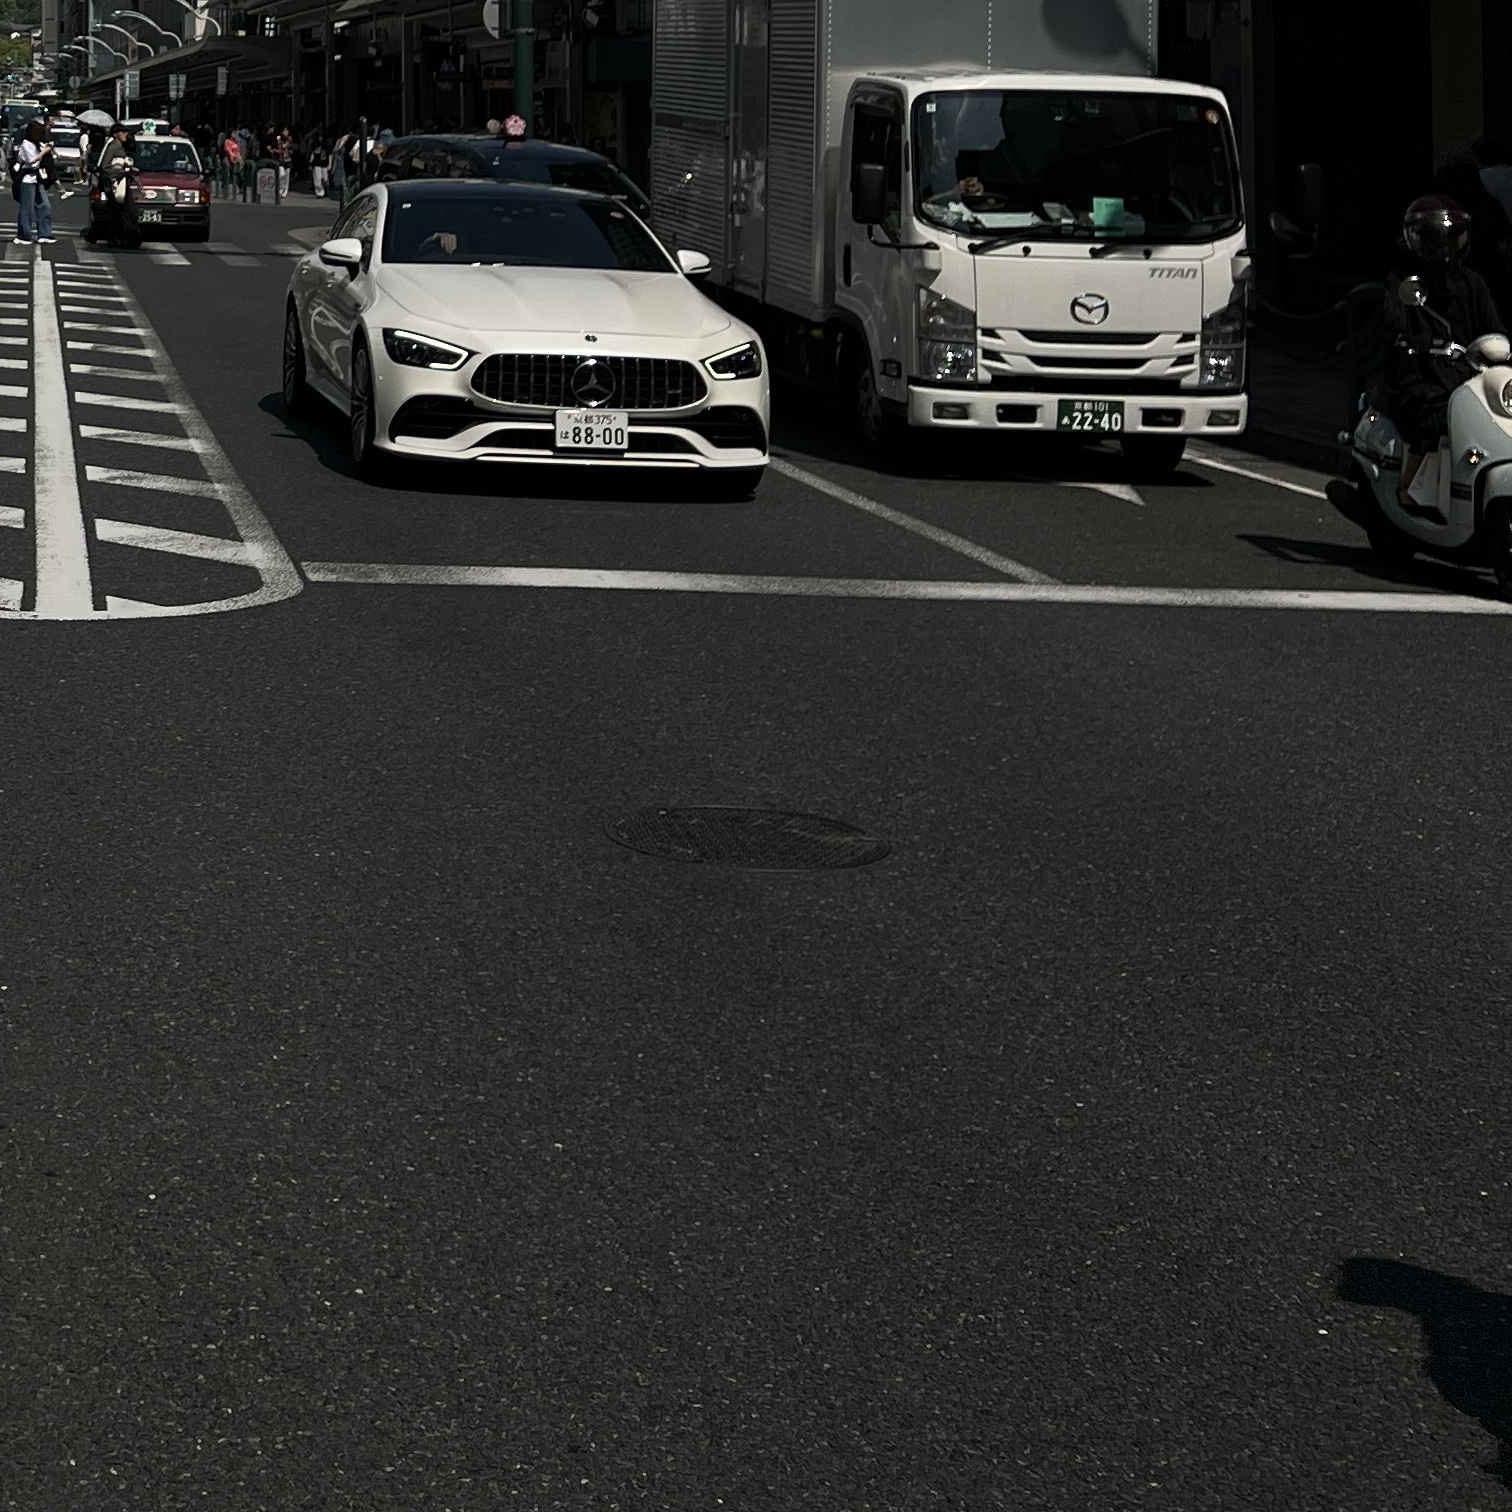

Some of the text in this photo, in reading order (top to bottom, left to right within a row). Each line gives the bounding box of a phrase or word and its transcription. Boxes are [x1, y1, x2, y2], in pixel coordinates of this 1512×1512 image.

[1149, 268, 1199, 280] TITAN
[1071, 411, 1122, 432] 22-40
[572, 427, 624, 445] 88-00
